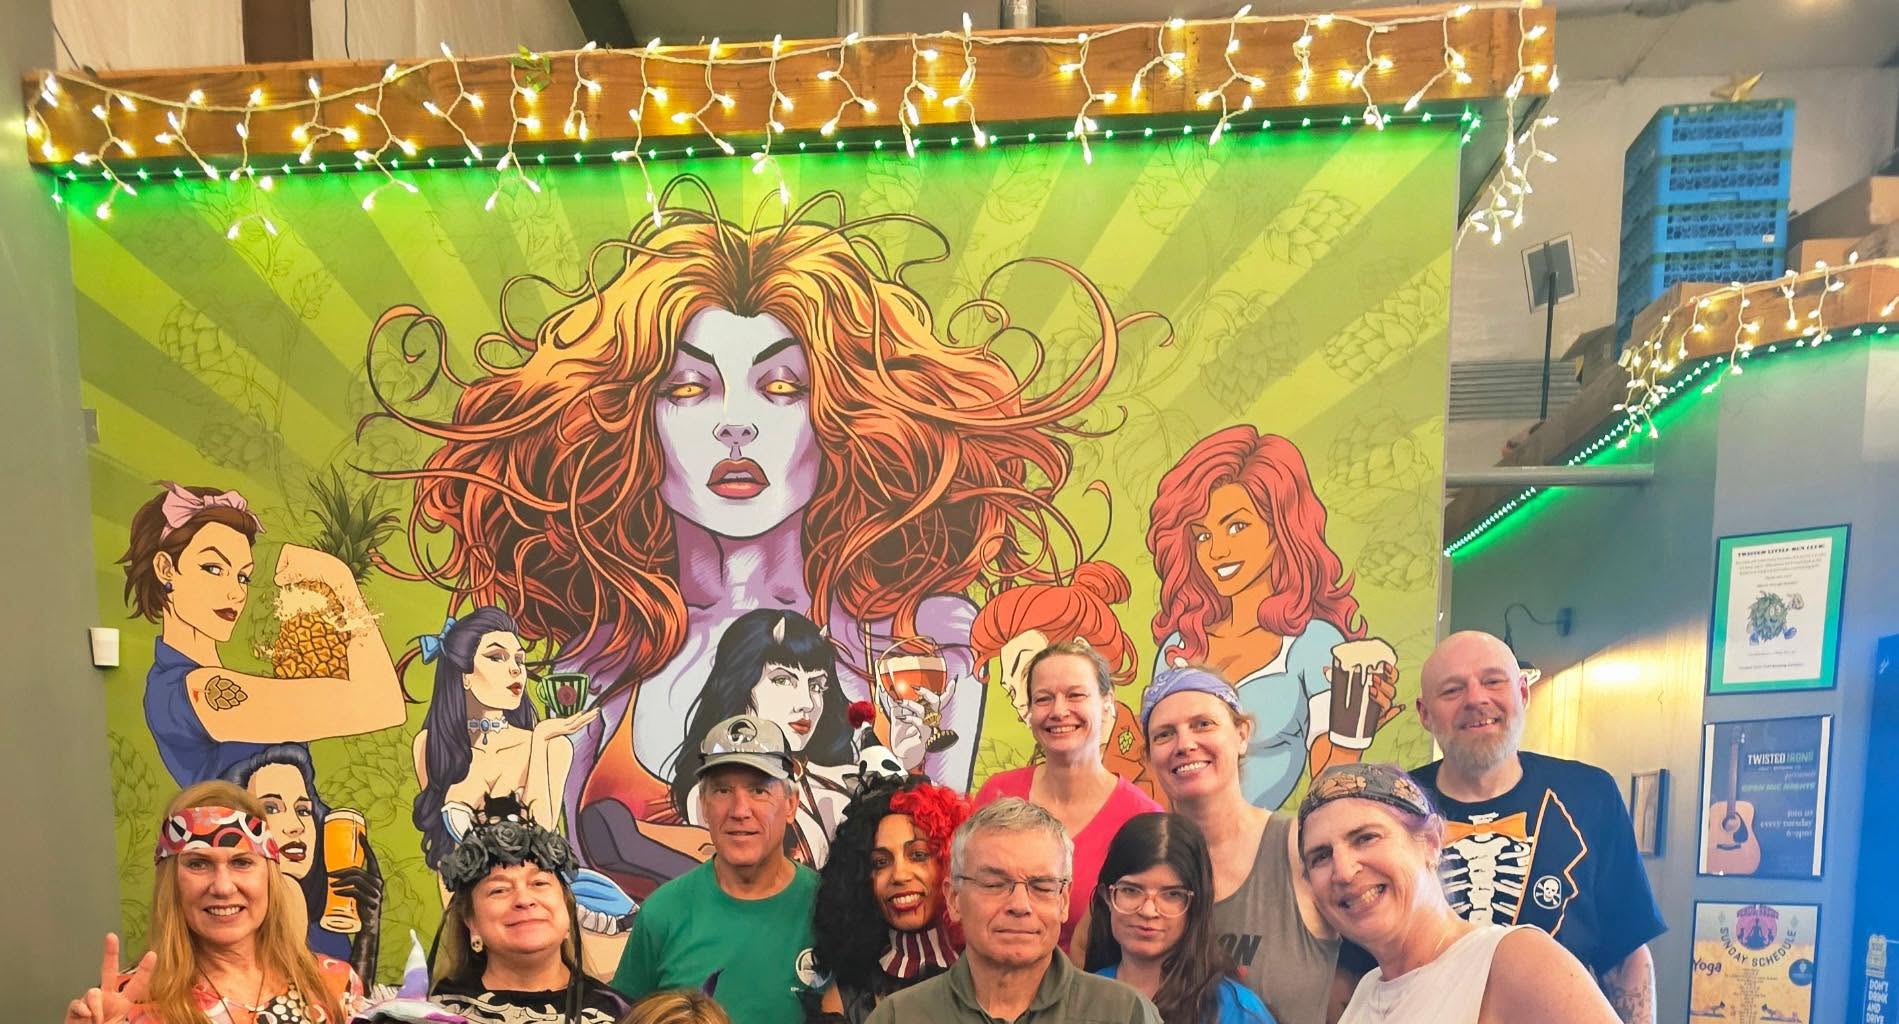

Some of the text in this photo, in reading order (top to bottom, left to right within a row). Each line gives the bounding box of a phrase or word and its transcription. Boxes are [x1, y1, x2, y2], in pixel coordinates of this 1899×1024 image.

[1748, 754, 1786, 765] TWISTED
[1719, 927, 1797, 967] SUNDAY SCHEDULE
[1693, 959, 1722, 976] Yoga
[1867, 1001, 1881, 1014] AND
